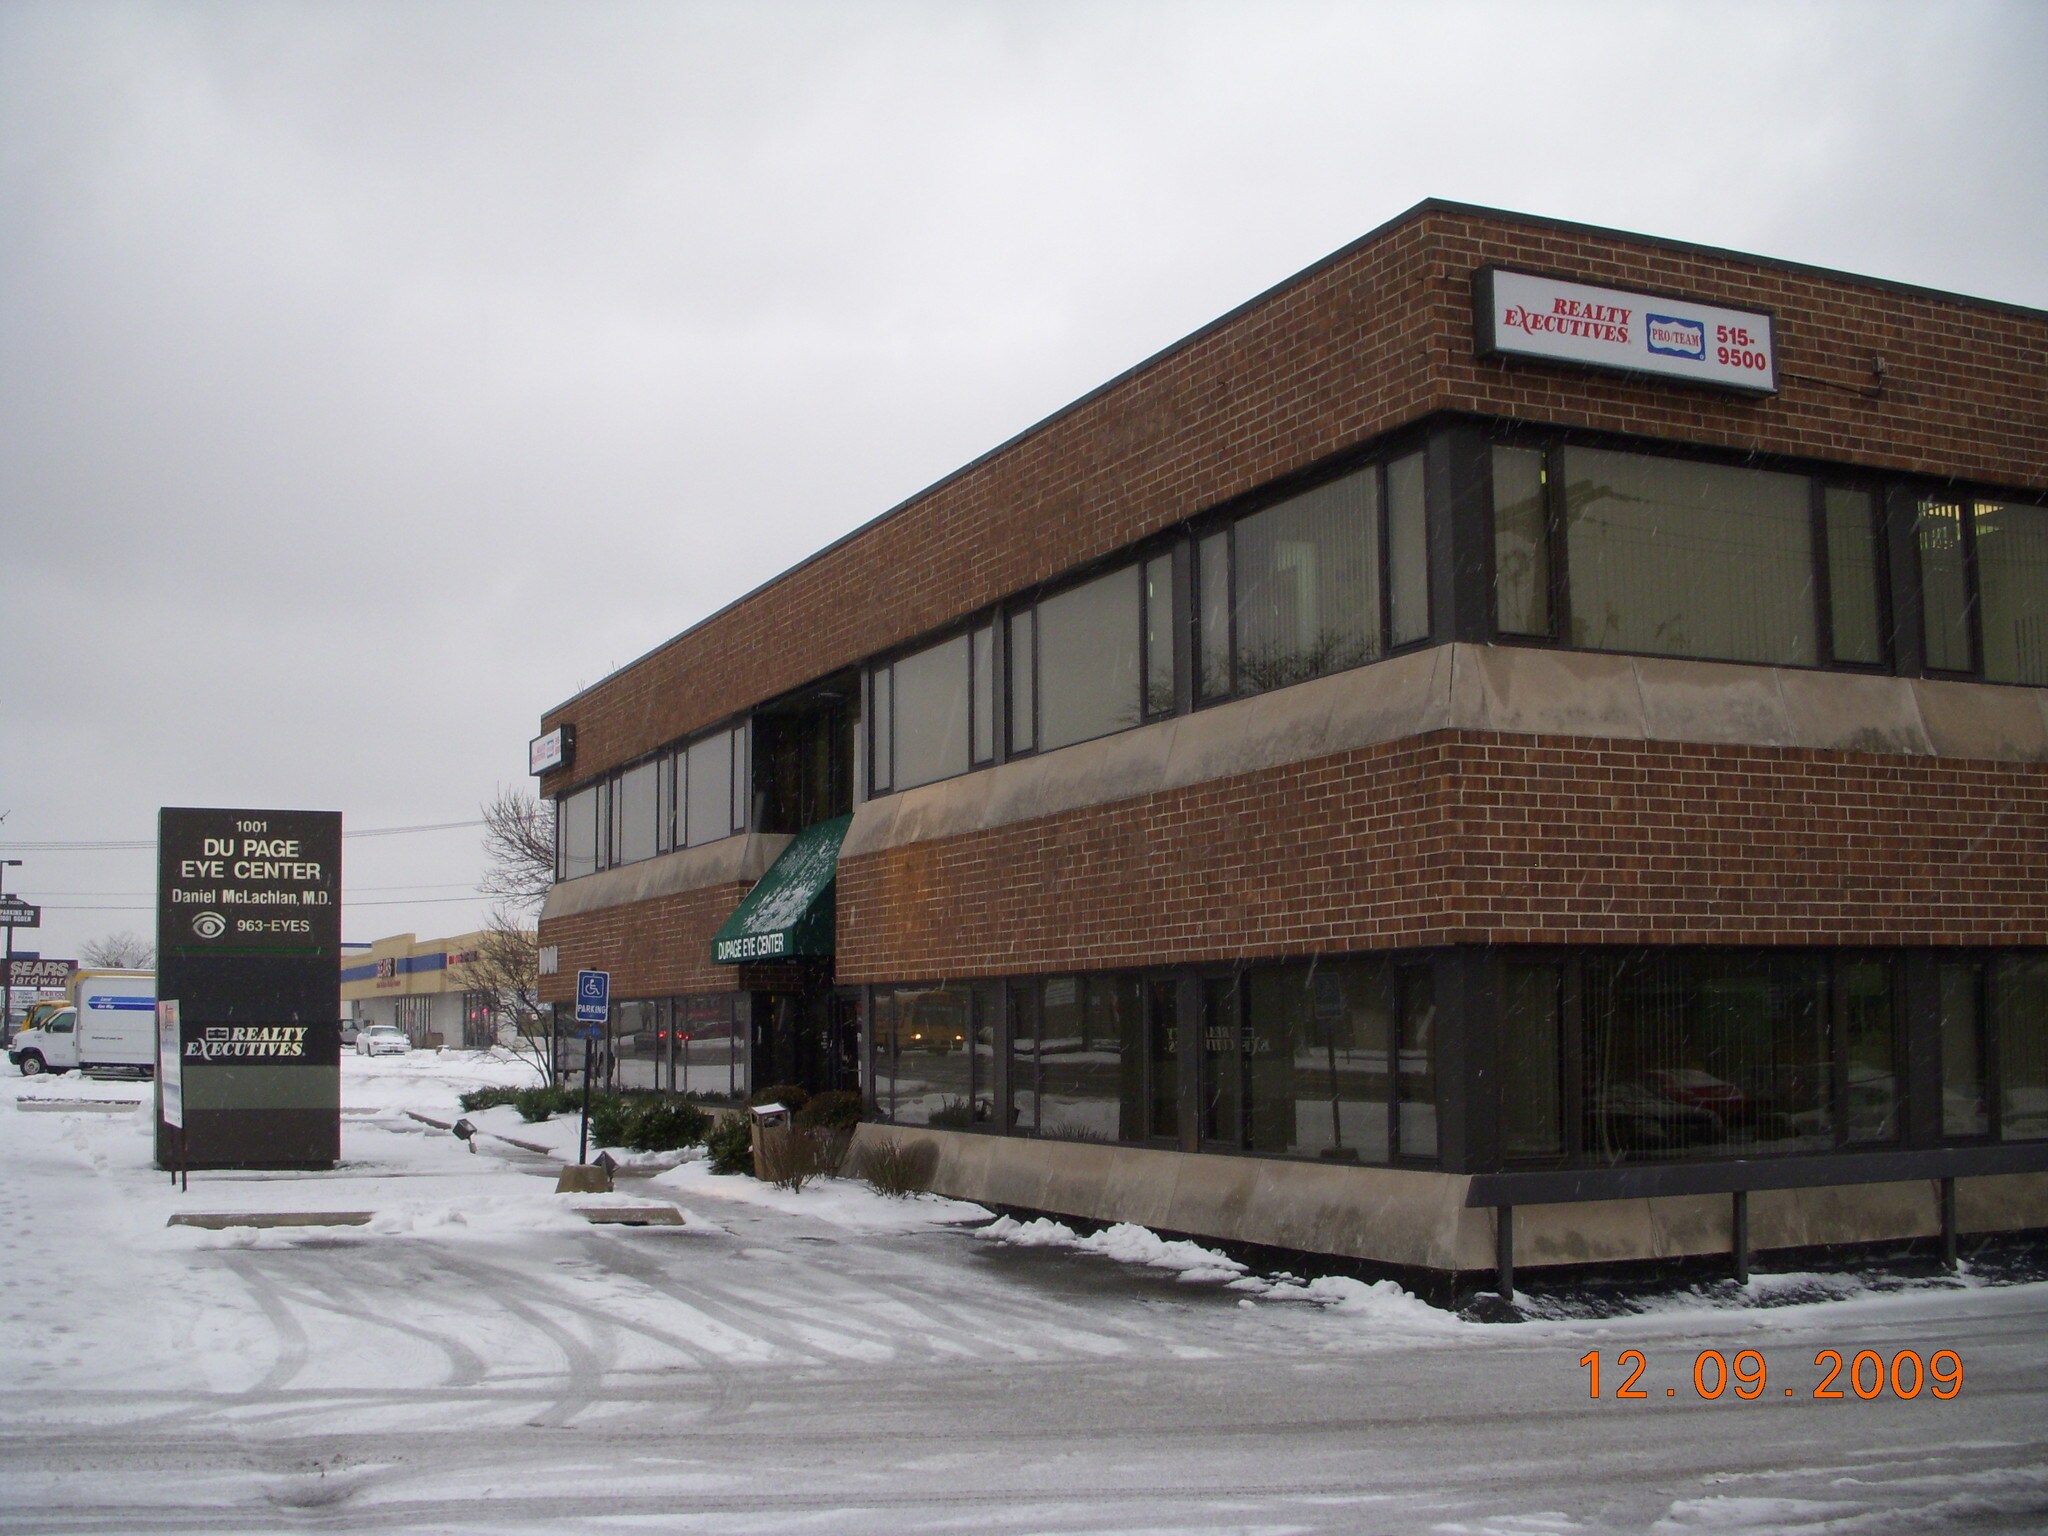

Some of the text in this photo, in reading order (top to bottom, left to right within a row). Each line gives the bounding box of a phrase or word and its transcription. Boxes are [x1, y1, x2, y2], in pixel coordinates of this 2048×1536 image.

[1553, 297, 1632, 326] REALTY
[1503, 304, 1629, 344] EXECUTIVES
[1651, 328, 1701, 348] PRO/TEAM
[1716, 325, 1755, 347] 515-
[1717, 346, 1766, 371] 9500
[236, 820, 268, 833] 1001
[204, 838, 300, 858] DU PAGE
[181, 860, 321, 880] EYE CENTER
[172, 888, 332, 907] Daniel McLachlan, M.D.
[237, 919, 310, 933] 963-EYES
[718, 932, 784, 960] DUPAGE EYE CENTER
[10, 961, 69, 977] SEARS
[578, 1004, 606, 1014] PARKING
[230, 1027, 309, 1042] REALTY
[184, 1037, 303, 1061] EXECUTIVES
